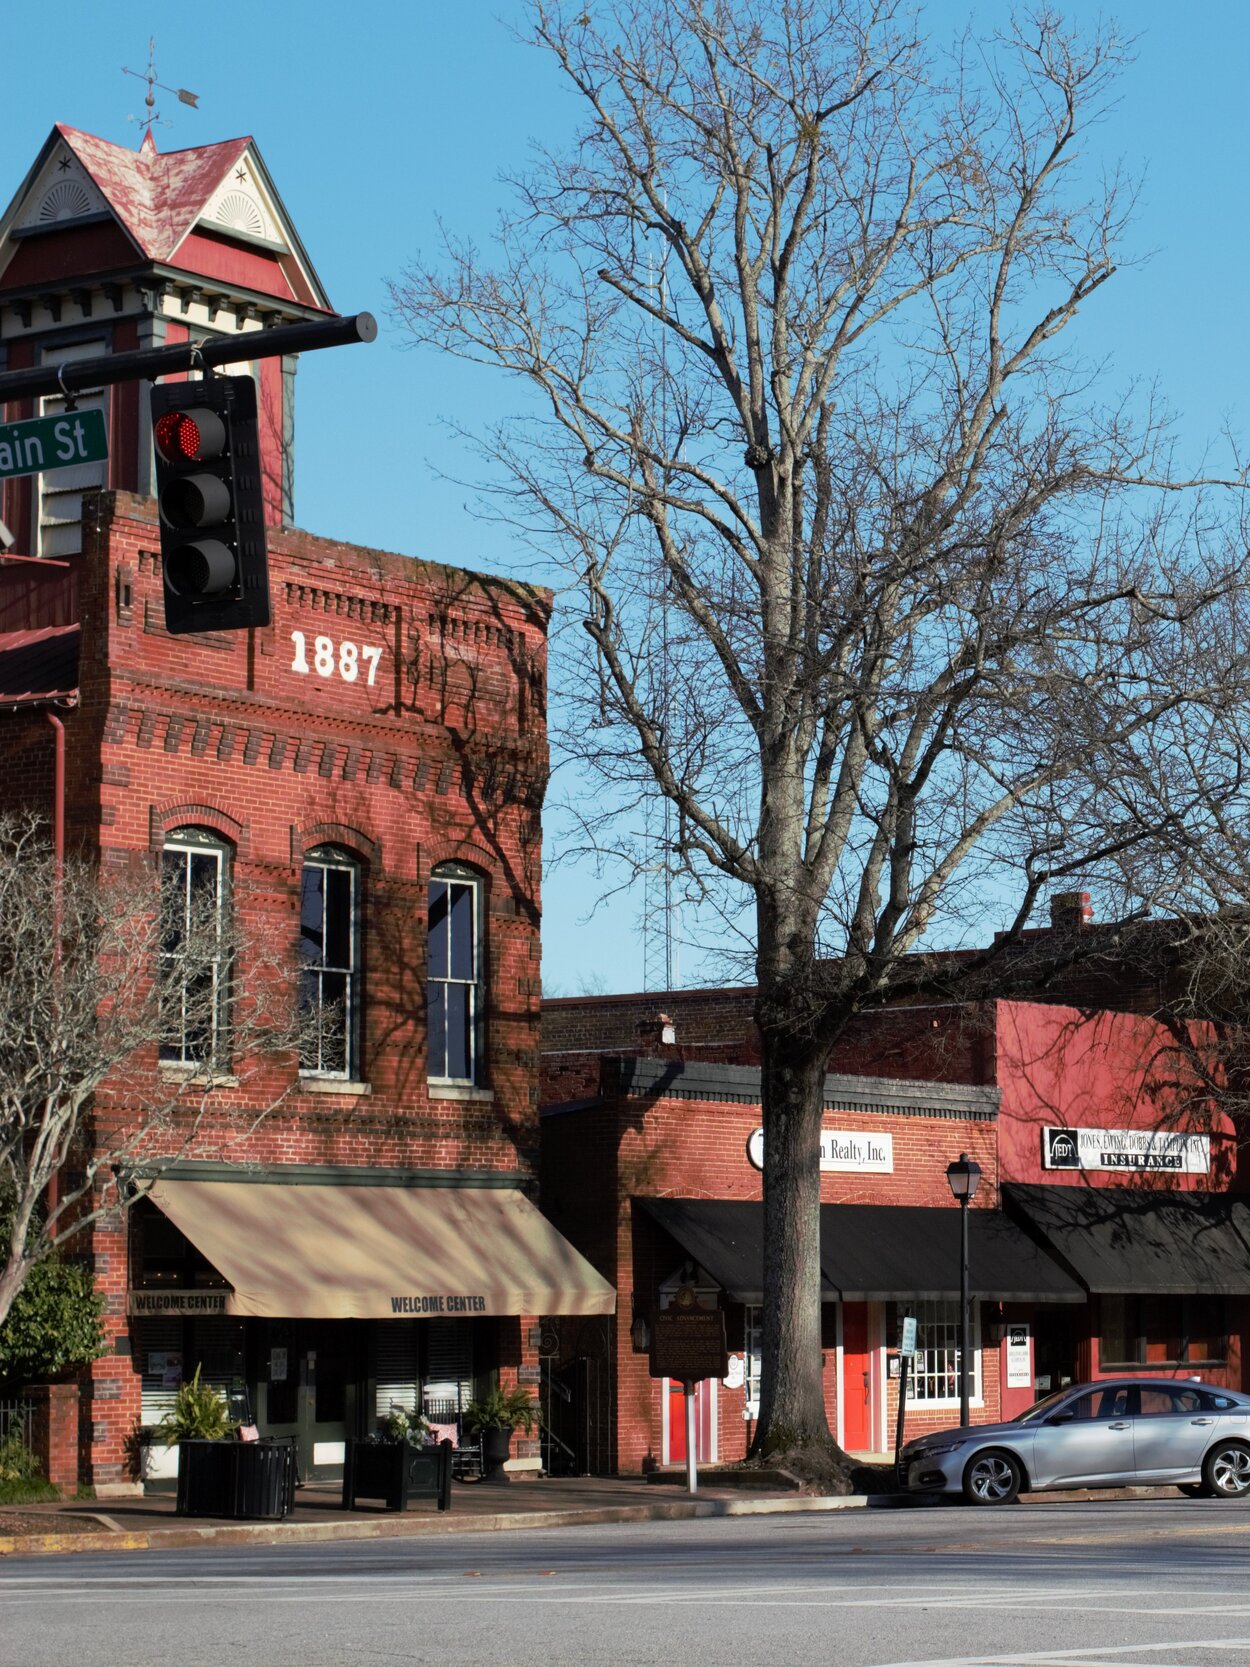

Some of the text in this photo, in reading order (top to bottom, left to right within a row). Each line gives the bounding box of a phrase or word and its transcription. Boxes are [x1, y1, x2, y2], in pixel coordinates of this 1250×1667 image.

[54, 419, 88, 460] St
[291, 630, 383, 686] 1887
[831, 1139, 866, 1165] Realty,
[867, 1141, 886, 1161] Inc.
[1103, 1154, 1180, 1167] INSURANCE
[136, 1295, 226, 1309] WELCOME CENTER
[391, 1296, 486, 1313] WELCOME CENTER
